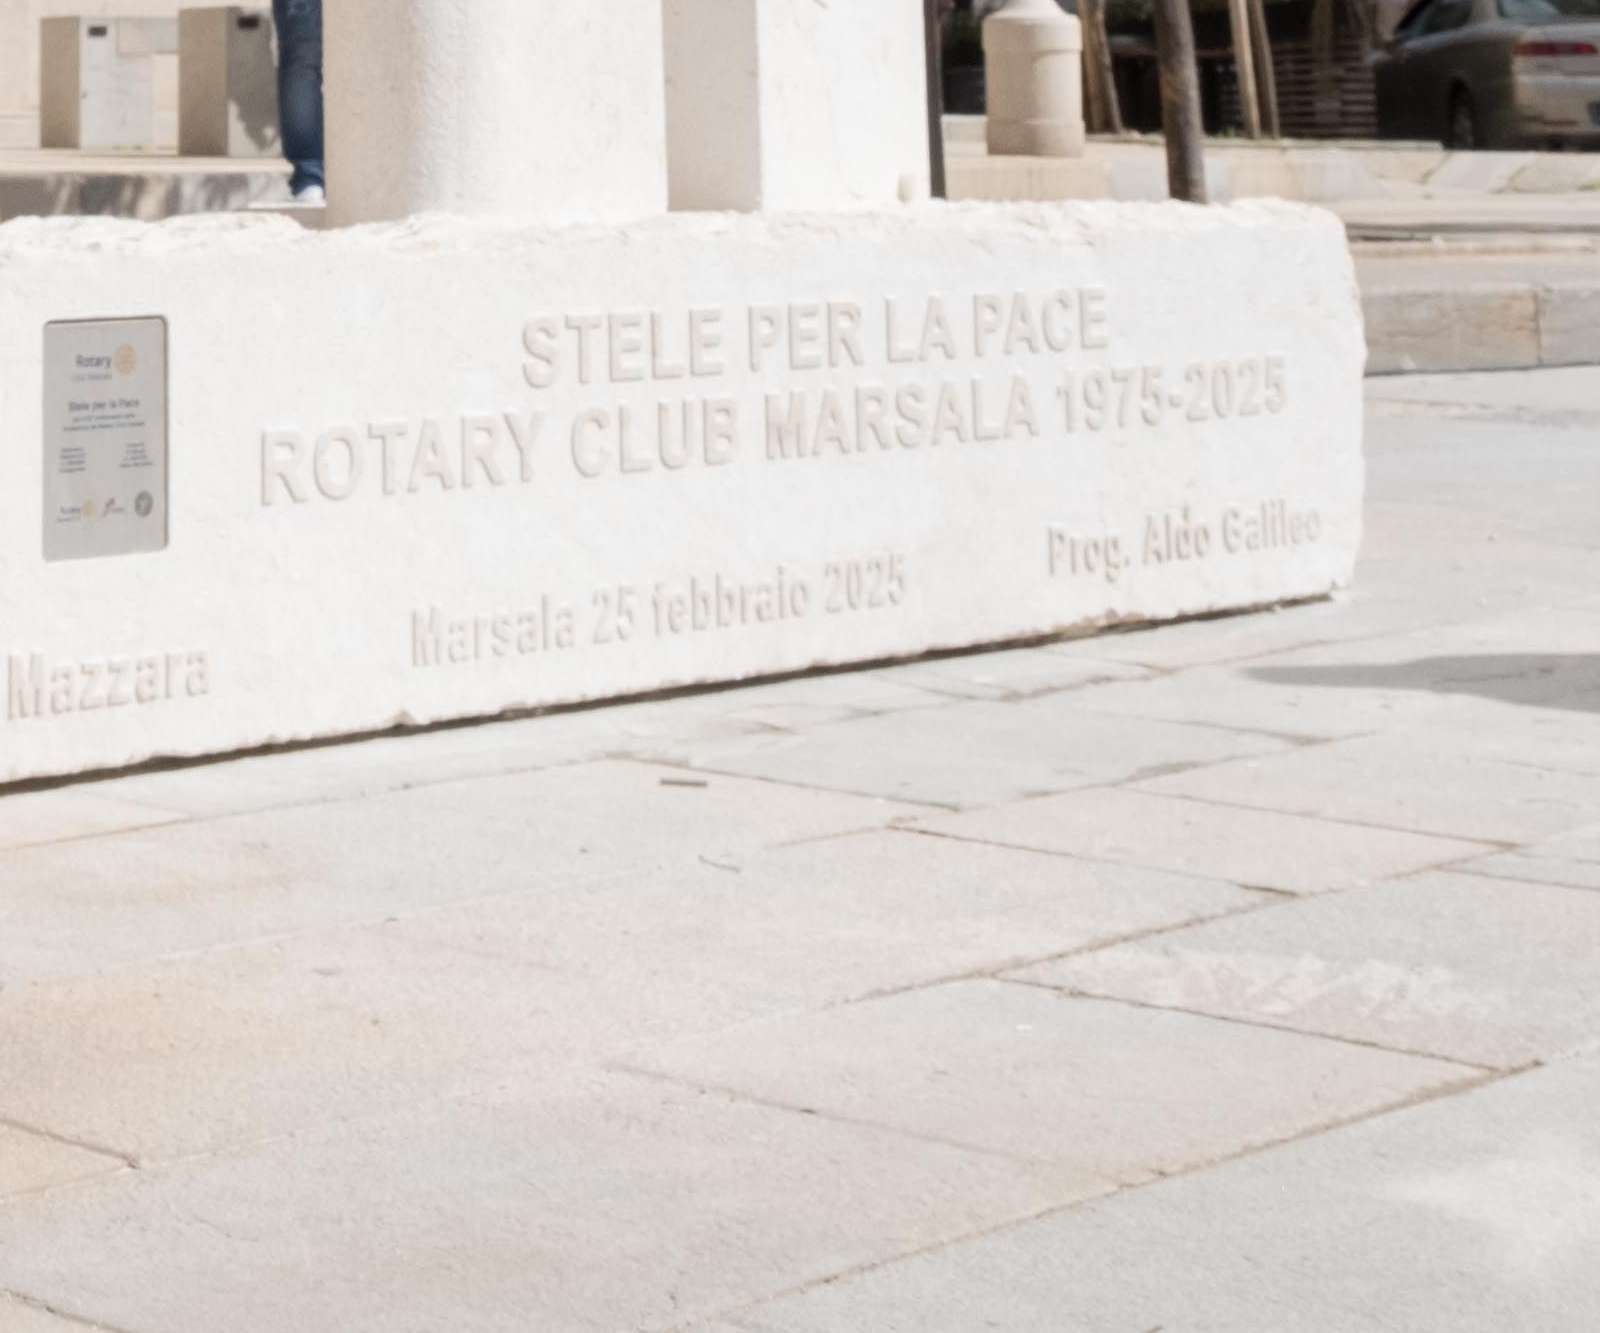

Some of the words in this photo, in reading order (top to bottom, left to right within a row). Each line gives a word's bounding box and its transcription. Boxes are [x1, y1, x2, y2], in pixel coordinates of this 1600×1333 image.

[521, 306, 725, 390] STELE
[747, 299, 865, 374] PER
[884, 294, 958, 365] LA
[971, 286, 1110, 358] PACE
[259, 410, 547, 507] ROTARY
[569, 395, 740, 480] CLUB
[764, 372, 1041, 461] MARSALA
[1055, 354, 1288, 434] 1975-2025
[1046, 524, 1131, 584] Prog.
[1141, 503, 1212, 566] Aldo
[1221, 498, 1323, 555] Galileo
[410, 593, 575, 667] Marsala
[591, 584, 635, 645] 25
[649, 565, 810, 639] febbraio
[824, 553, 906, 616] 2025
[6, 647, 212, 722] Mazzara
